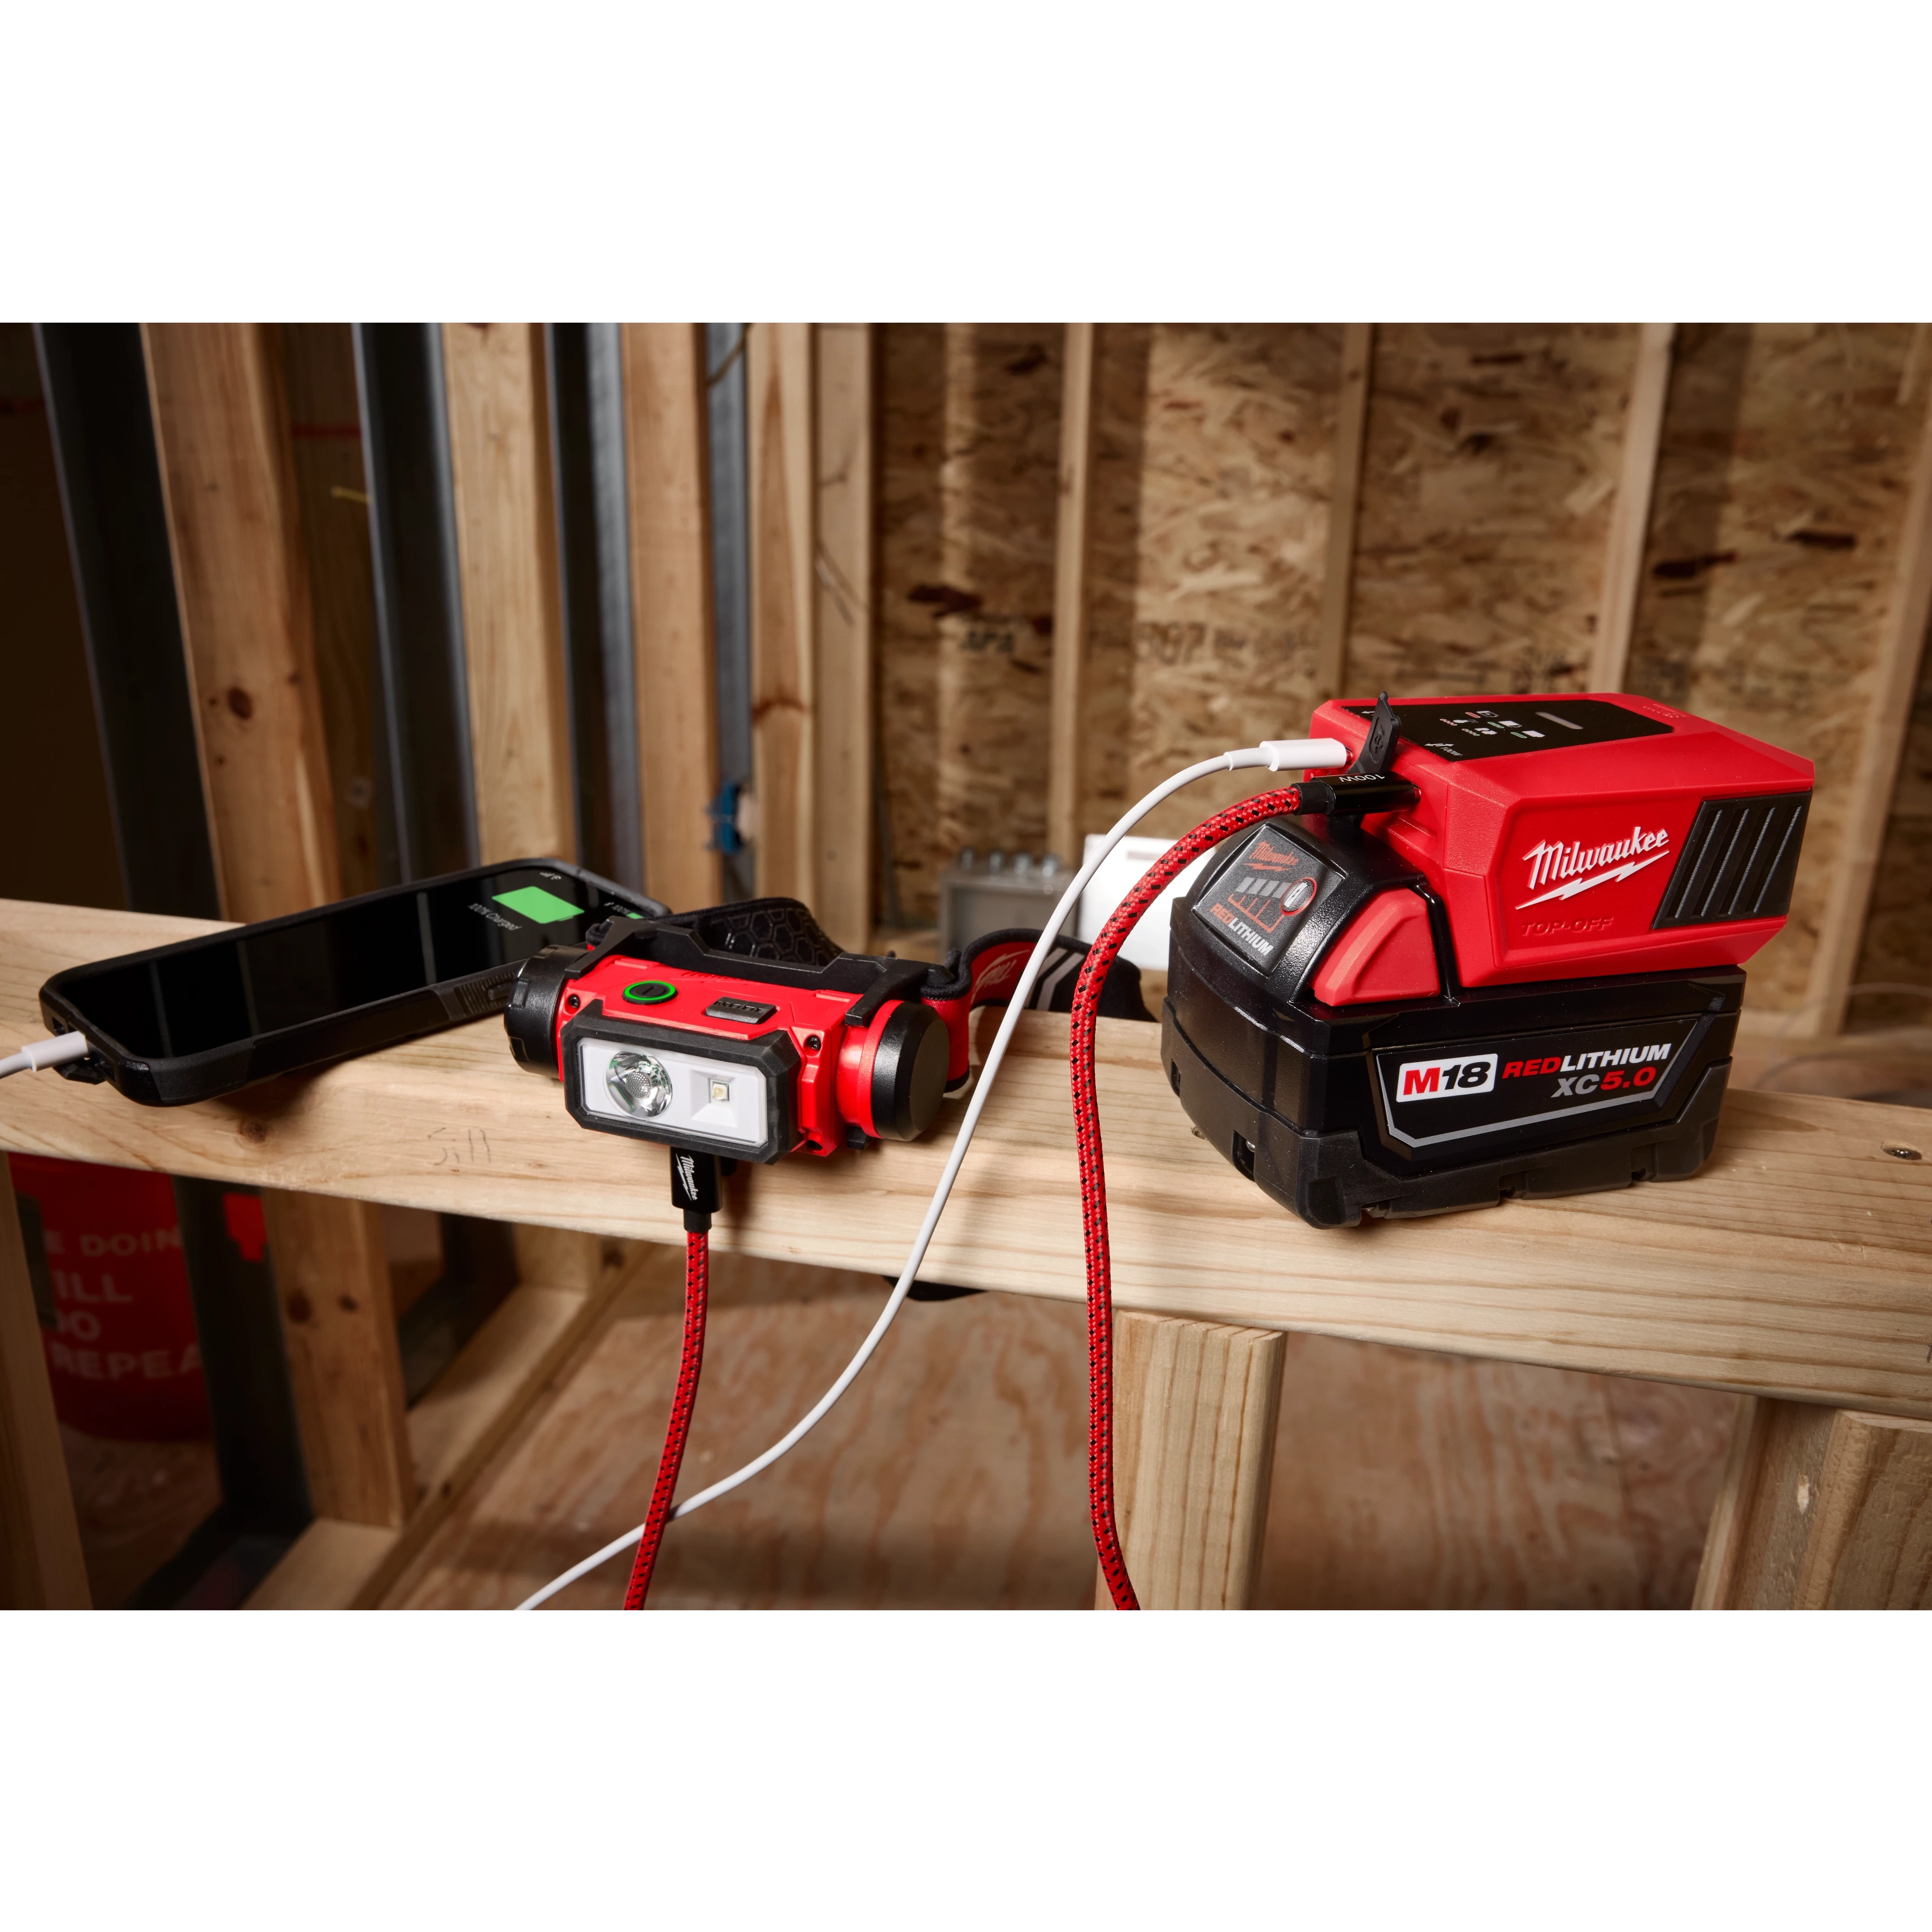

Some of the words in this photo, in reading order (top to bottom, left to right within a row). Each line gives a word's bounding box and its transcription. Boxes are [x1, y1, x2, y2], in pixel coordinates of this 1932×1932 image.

[1440, 747, 1463, 756] 100W
[1339, 774, 1385, 782] 100W
[1522, 826, 1670, 890] Milwaukee
[467, 903, 492, 915] 100%
[485, 912, 522, 931] Charged
[1210, 902, 1274, 956] REDLITHIUM
[1521, 917, 1614, 936] TOP-OFF
[713, 1000, 769, 1013] MODE
[1403, 1061, 1492, 1095] M18
[1502, 1043, 1672, 1079] REDLITHIUM
[680, 1155, 698, 1200] Milwaukee
